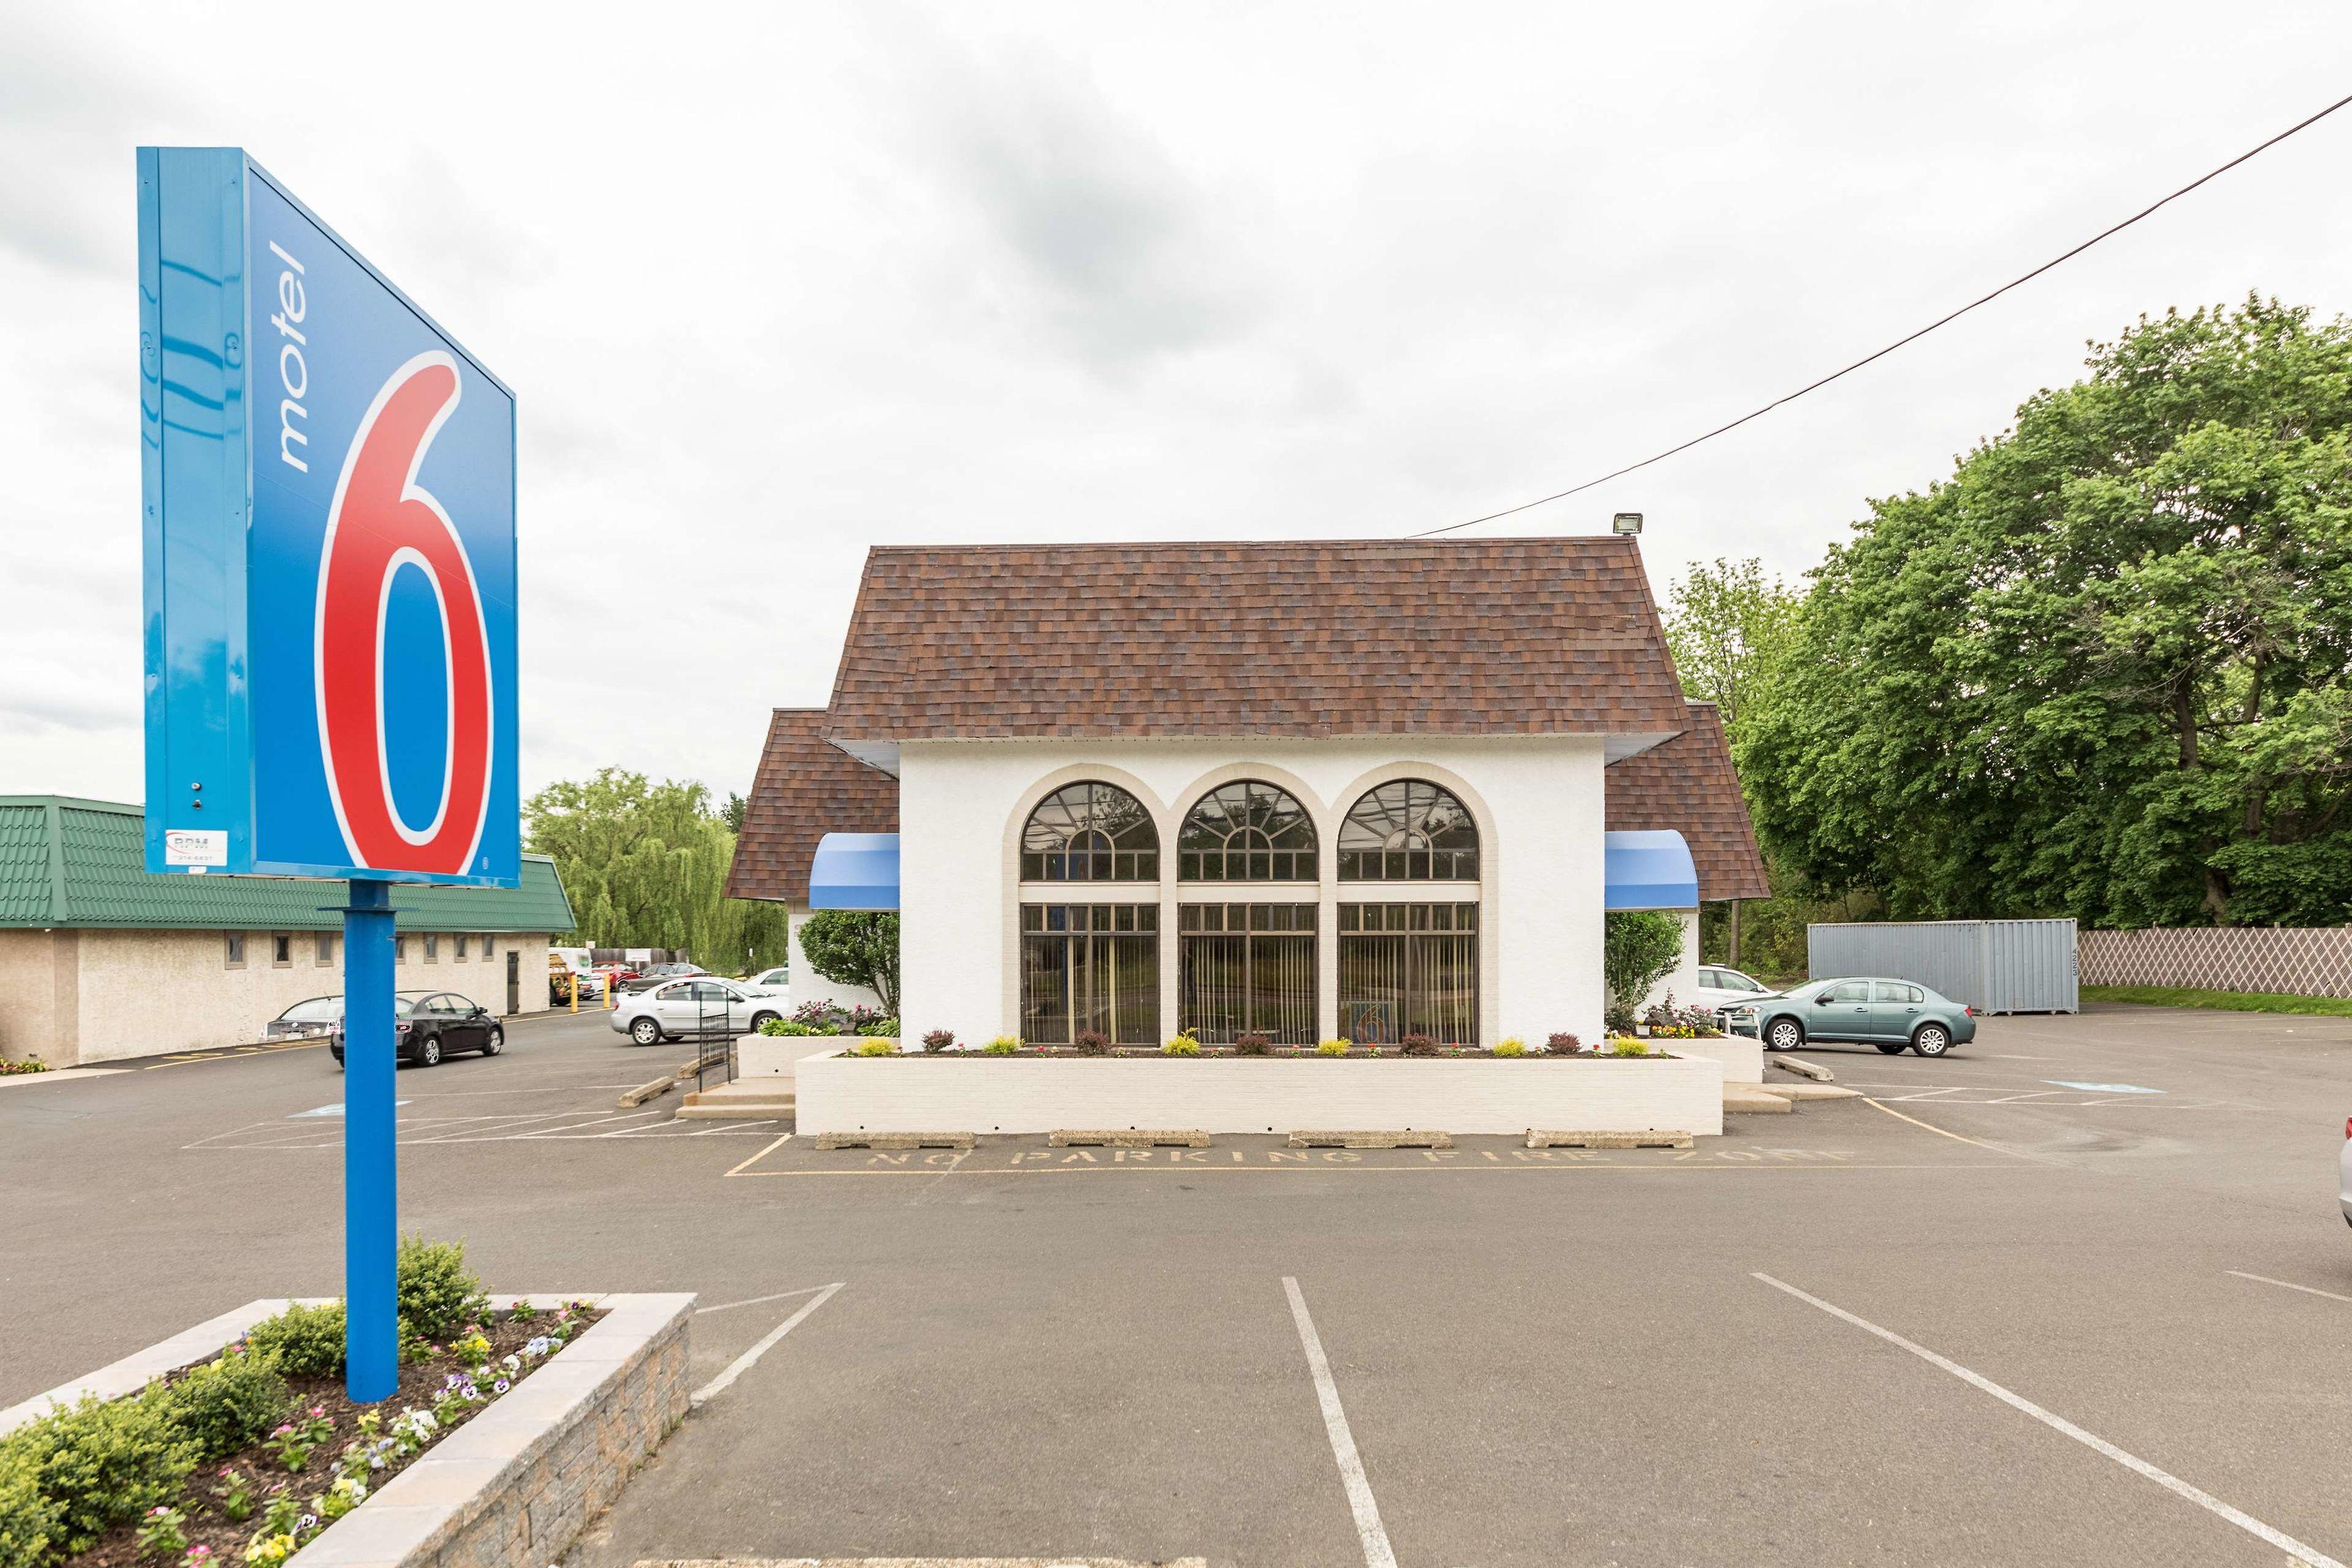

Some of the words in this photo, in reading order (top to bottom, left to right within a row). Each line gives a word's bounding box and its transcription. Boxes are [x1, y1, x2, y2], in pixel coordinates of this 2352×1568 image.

[269, 240, 308, 473] motel
[314, 349, 494, 876] 6
[870, 1153, 964, 1164] NO
[1011, 1150, 1363, 1164] PARKING
[1421, 1151, 1611, 1162] FIRE
